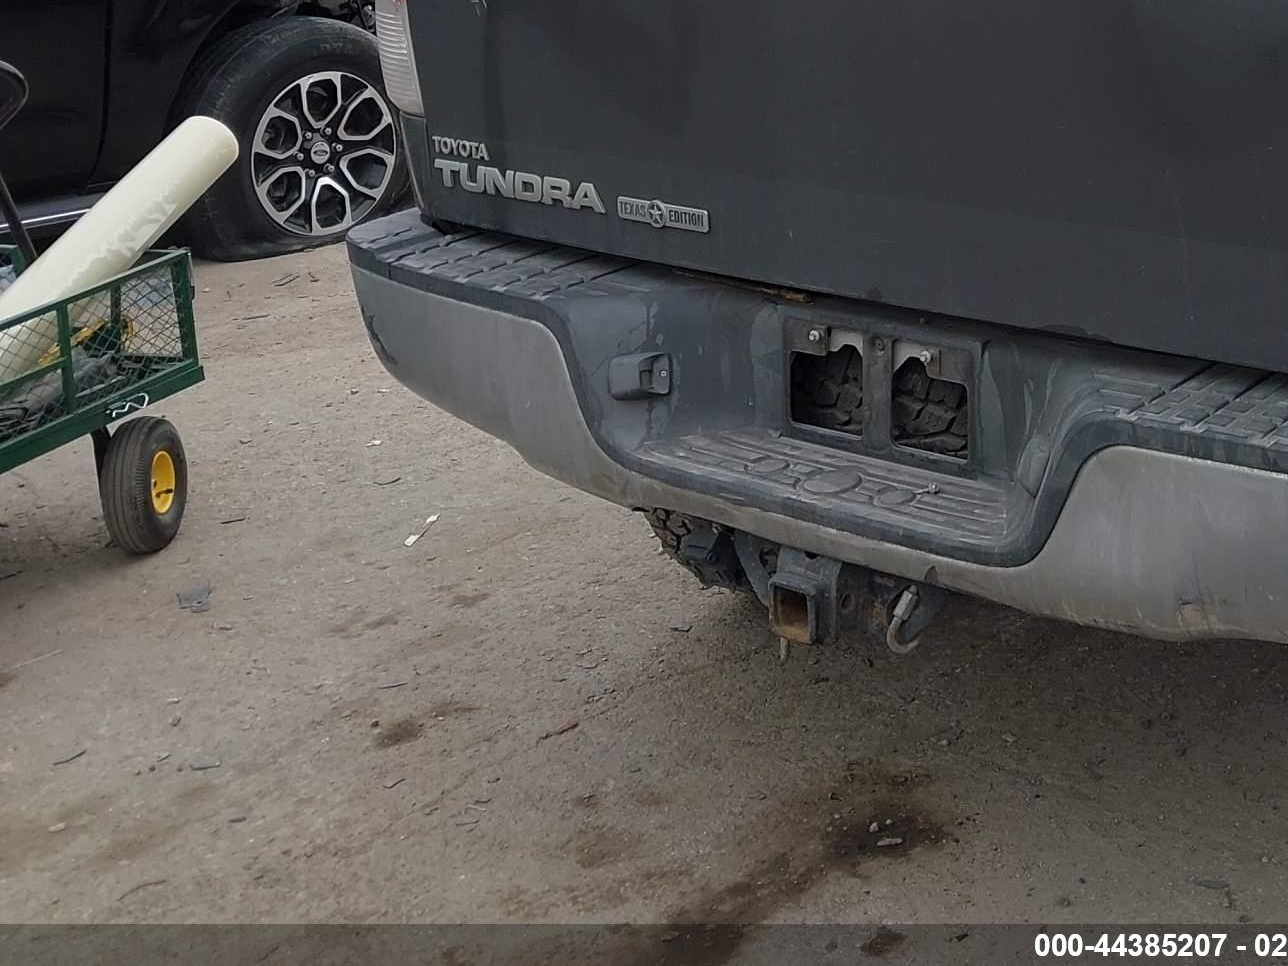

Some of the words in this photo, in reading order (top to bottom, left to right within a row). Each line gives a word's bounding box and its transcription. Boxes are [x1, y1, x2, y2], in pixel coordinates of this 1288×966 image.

[432, 135, 490, 161] TOYOTA
[433, 158, 607, 214] TUNDRA
[618, 199, 647, 219] TEXAS
[667, 208, 706, 228] EDITION
